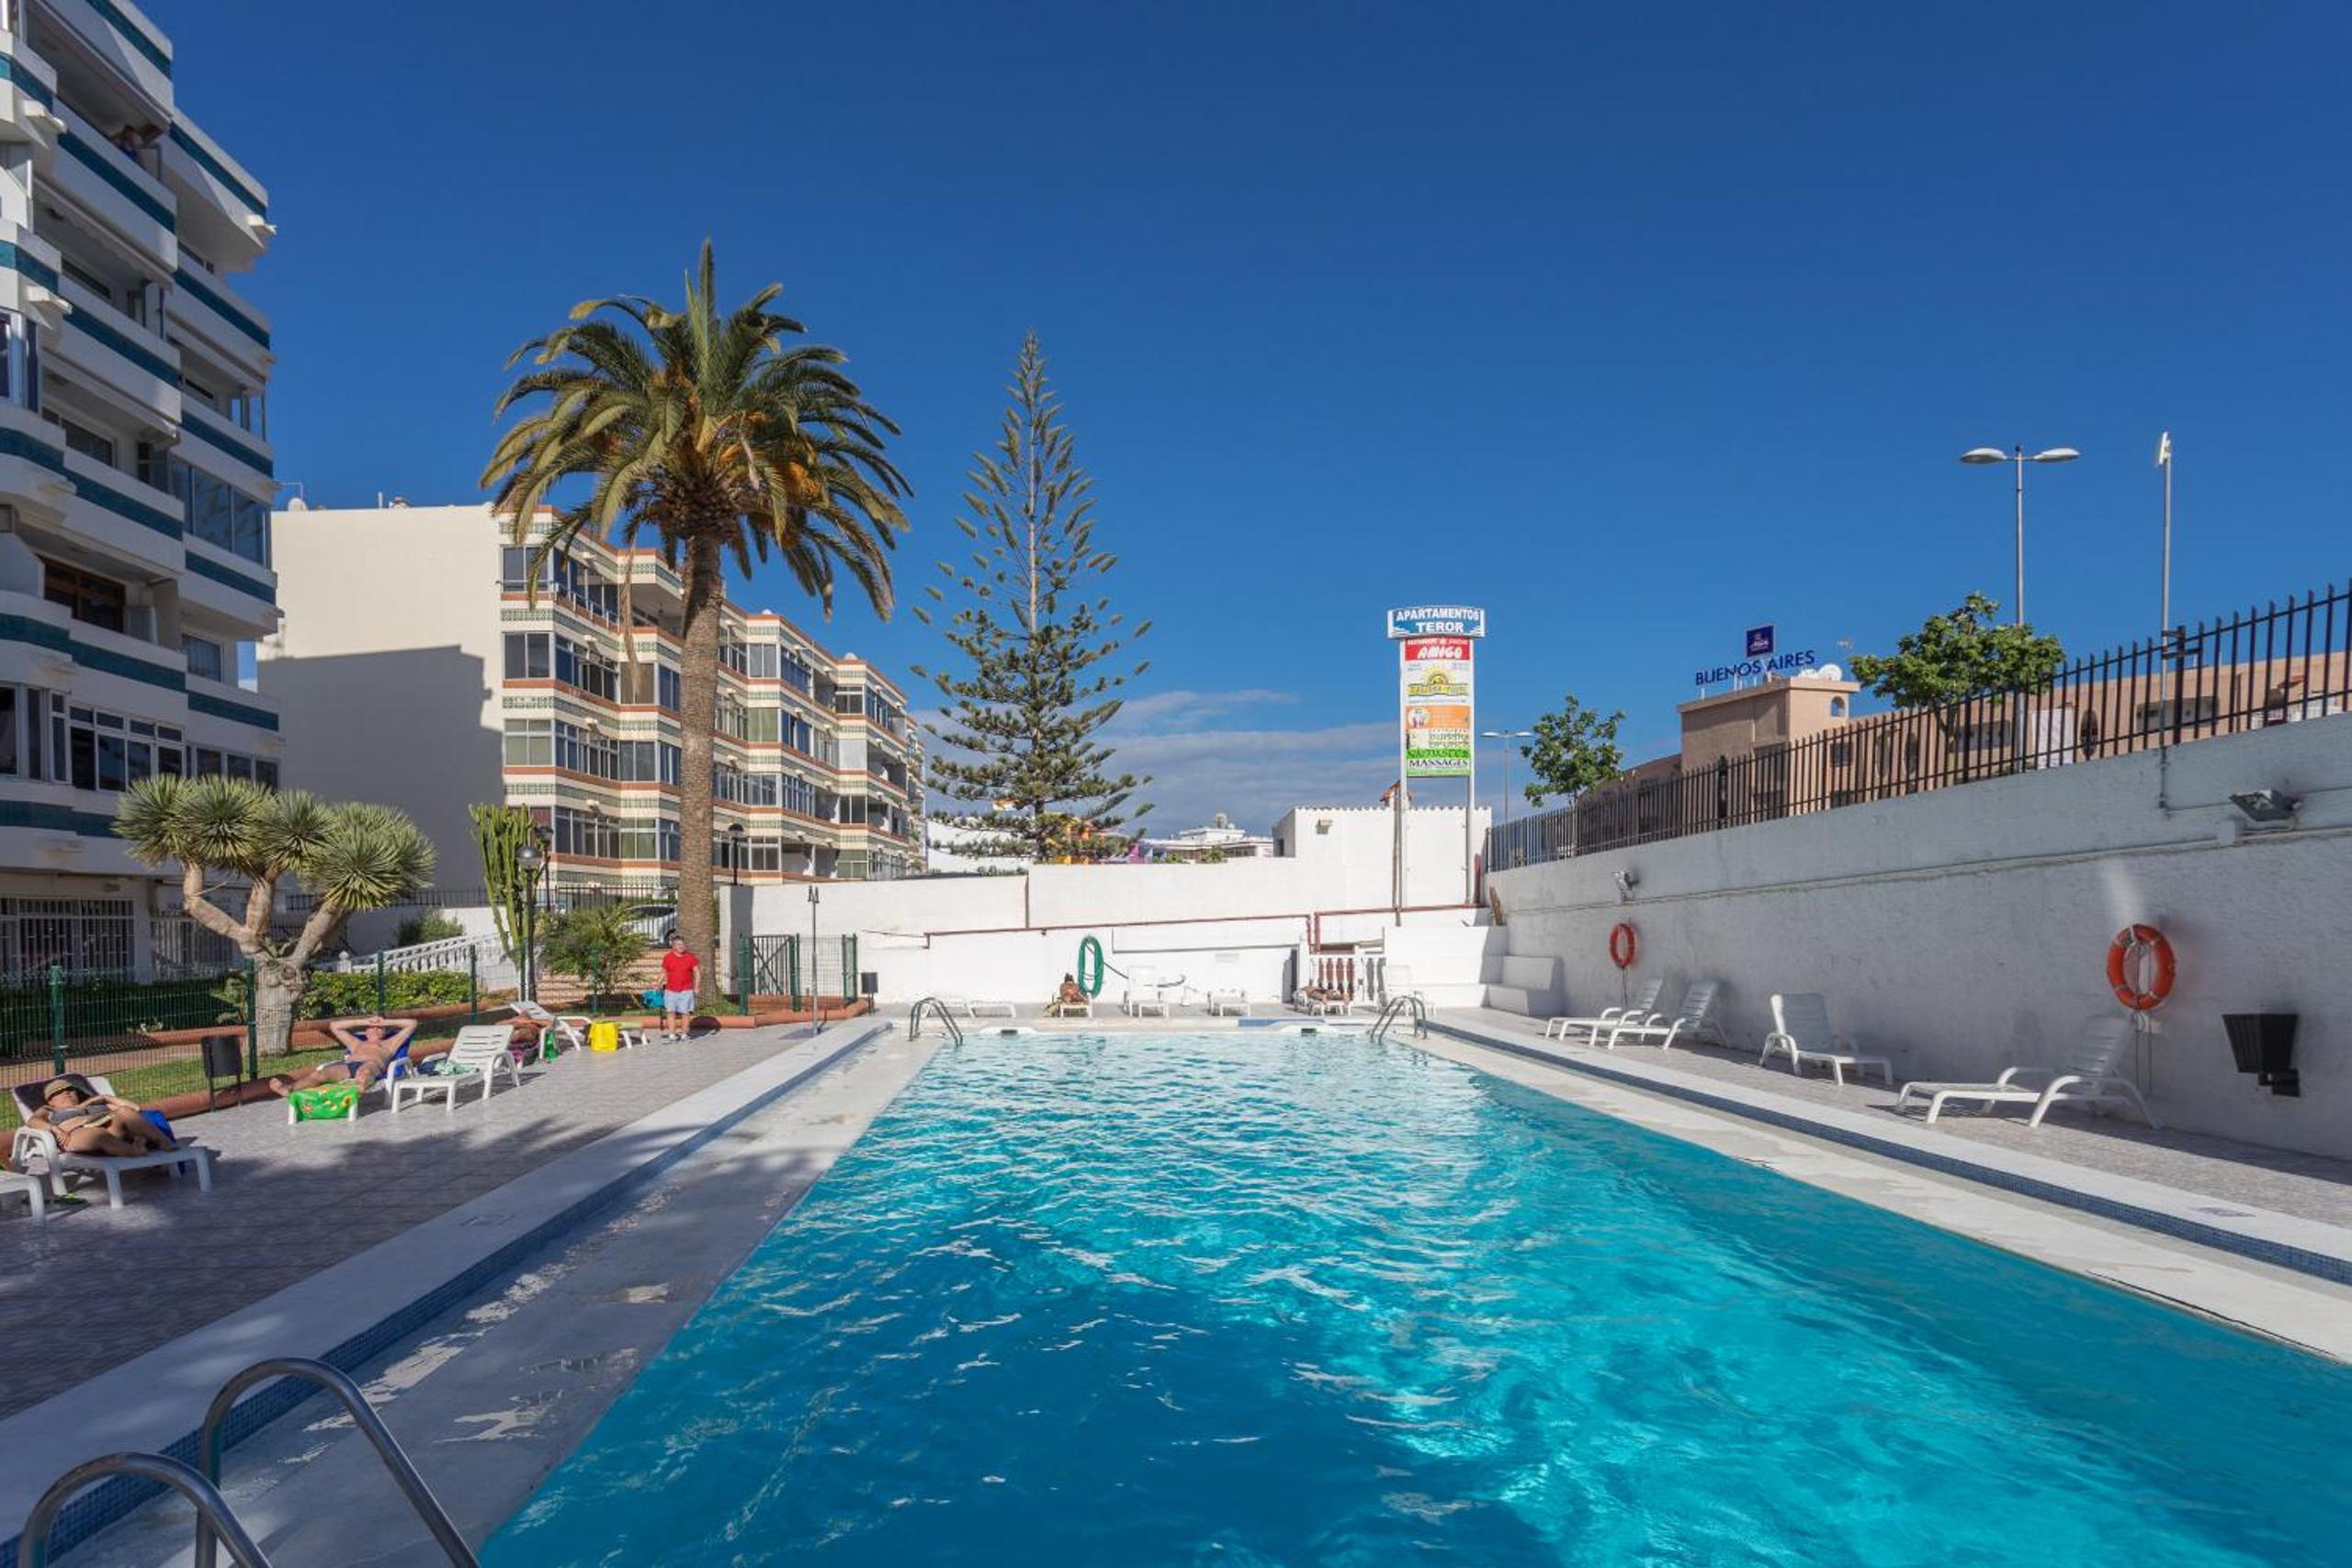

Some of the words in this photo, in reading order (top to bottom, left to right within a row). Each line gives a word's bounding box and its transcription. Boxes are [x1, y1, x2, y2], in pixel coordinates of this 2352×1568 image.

[1396, 608, 1479, 621] APARTAMENTOS
[1416, 622, 1464, 633] TEROR
[1417, 646, 1463, 660] AMIGO
[1695, 660, 1761, 686] BUENOS
[1767, 649, 1815, 671] AIRES
[1408, 758, 1468, 768] MASSAGES
